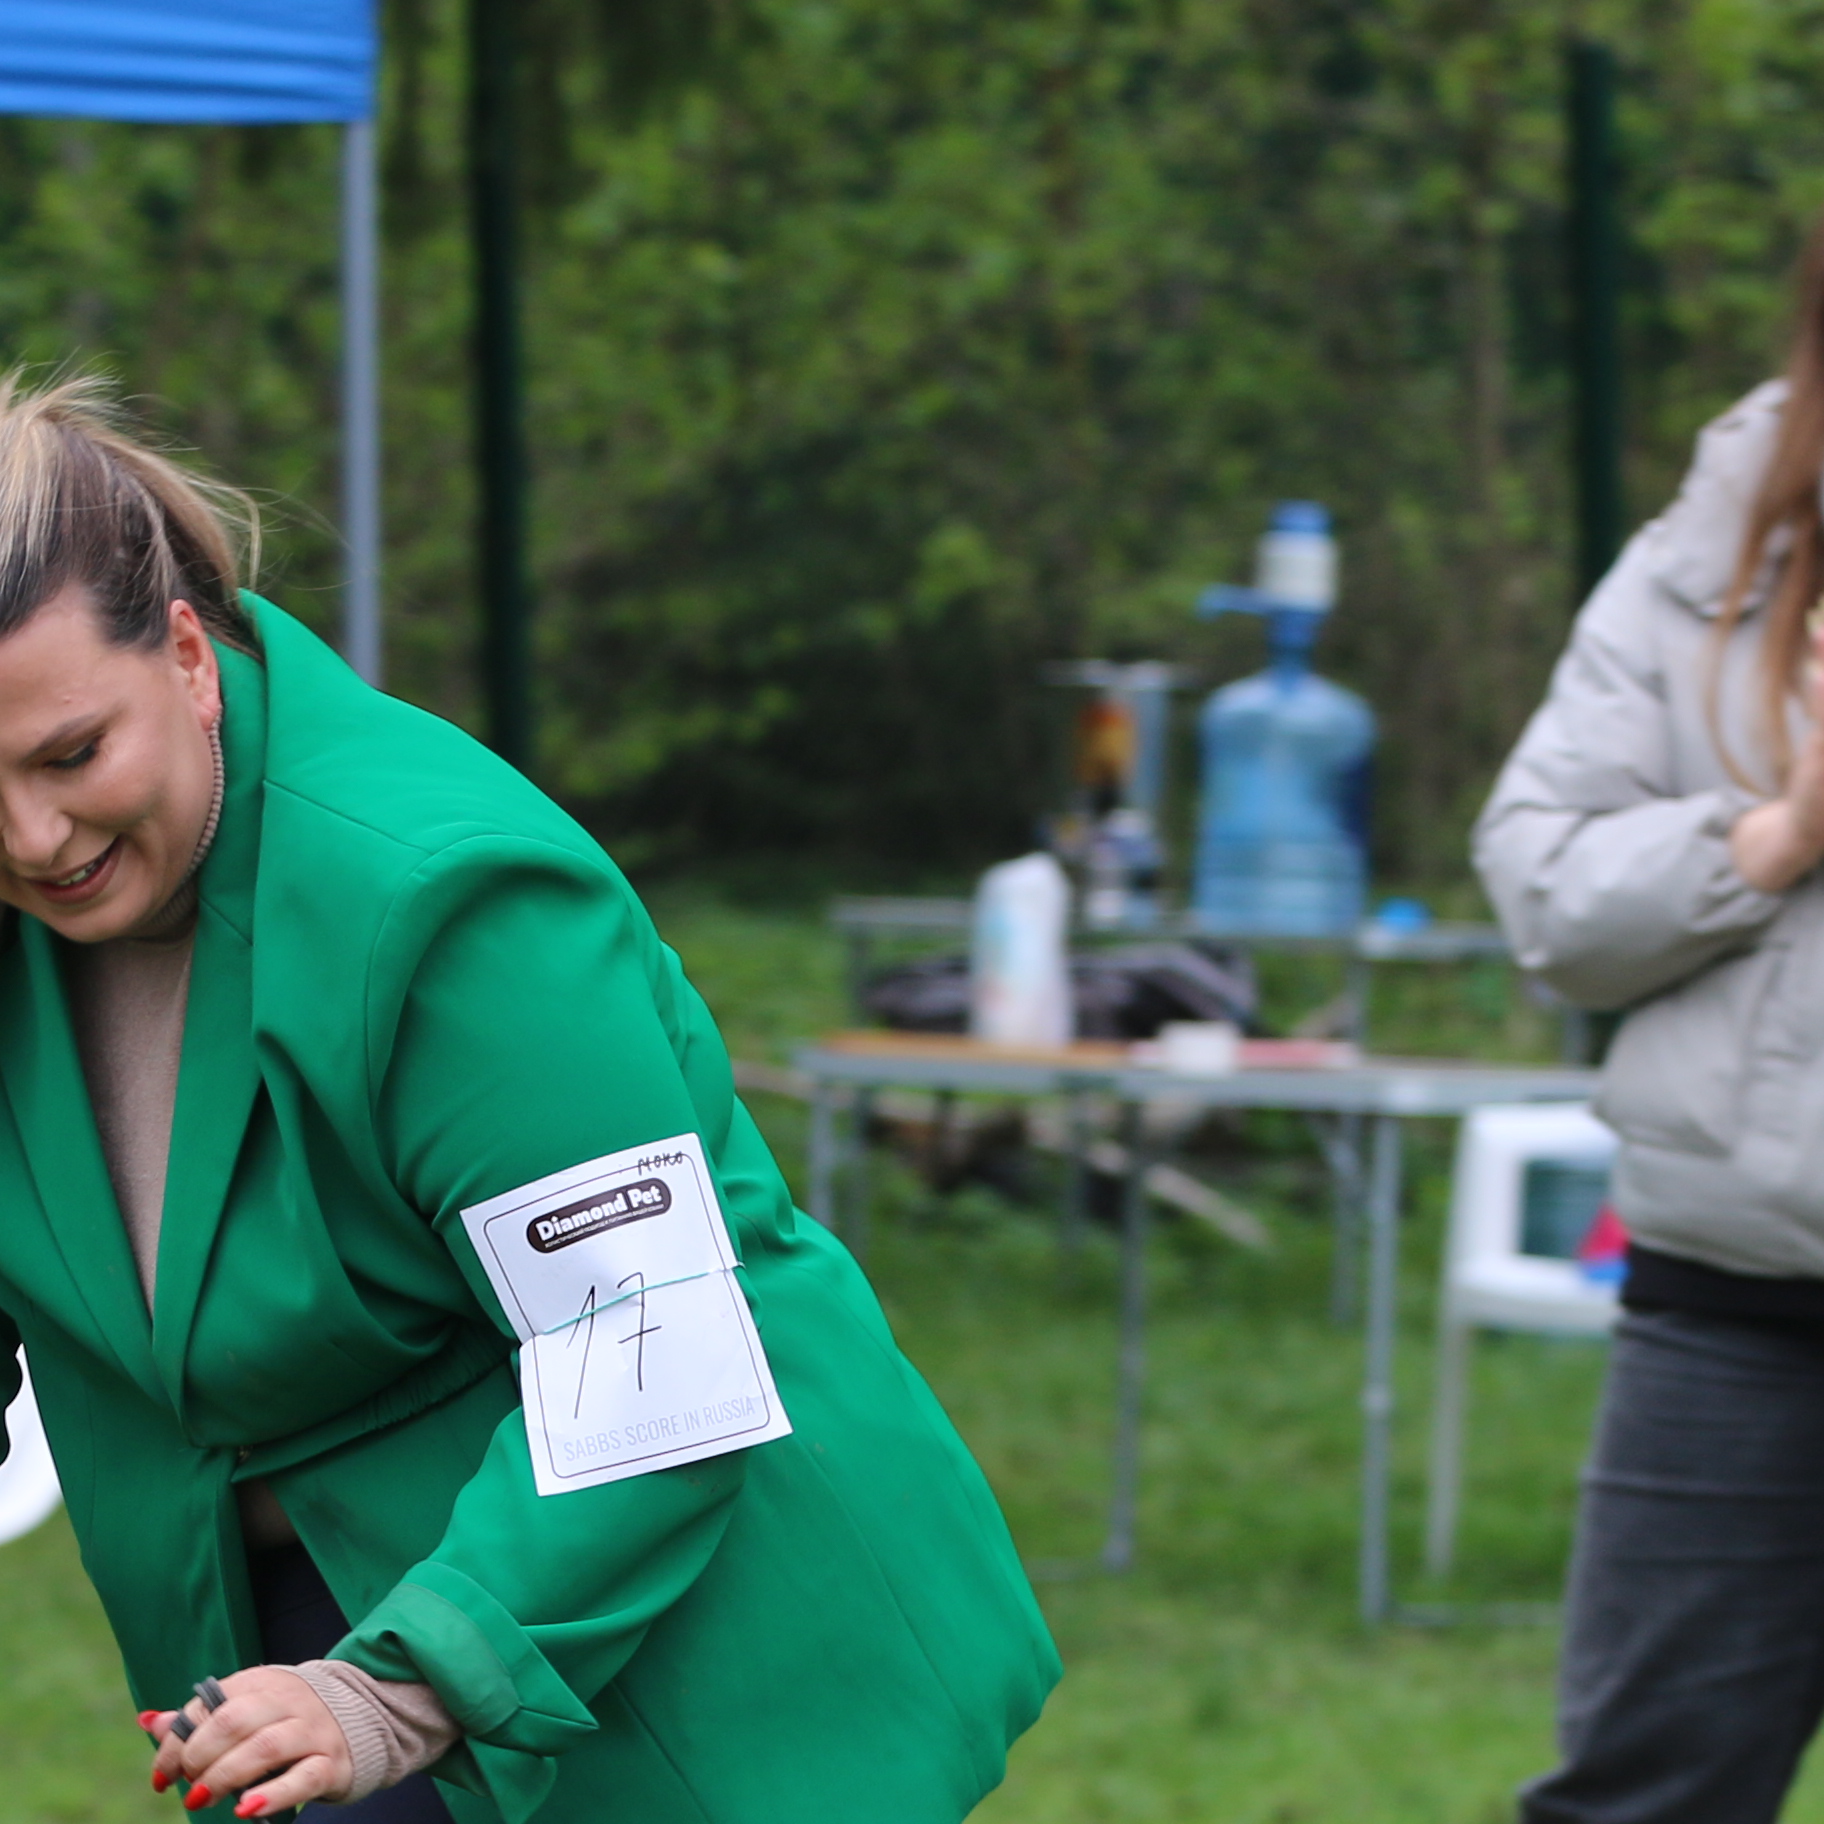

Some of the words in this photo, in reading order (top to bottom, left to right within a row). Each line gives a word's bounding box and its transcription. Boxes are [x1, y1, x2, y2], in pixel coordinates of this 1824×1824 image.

[535, 1192, 627, 1241] Diamond
[627, 1185, 663, 1208] Pet
[566, 1271, 662, 1419] 17
[563, 1430, 621, 1462] SABBS
[625, 1415, 681, 1446] SCORE
[685, 1411, 701, 1432] IN
[705, 1396, 756, 1427] RUSSIA
